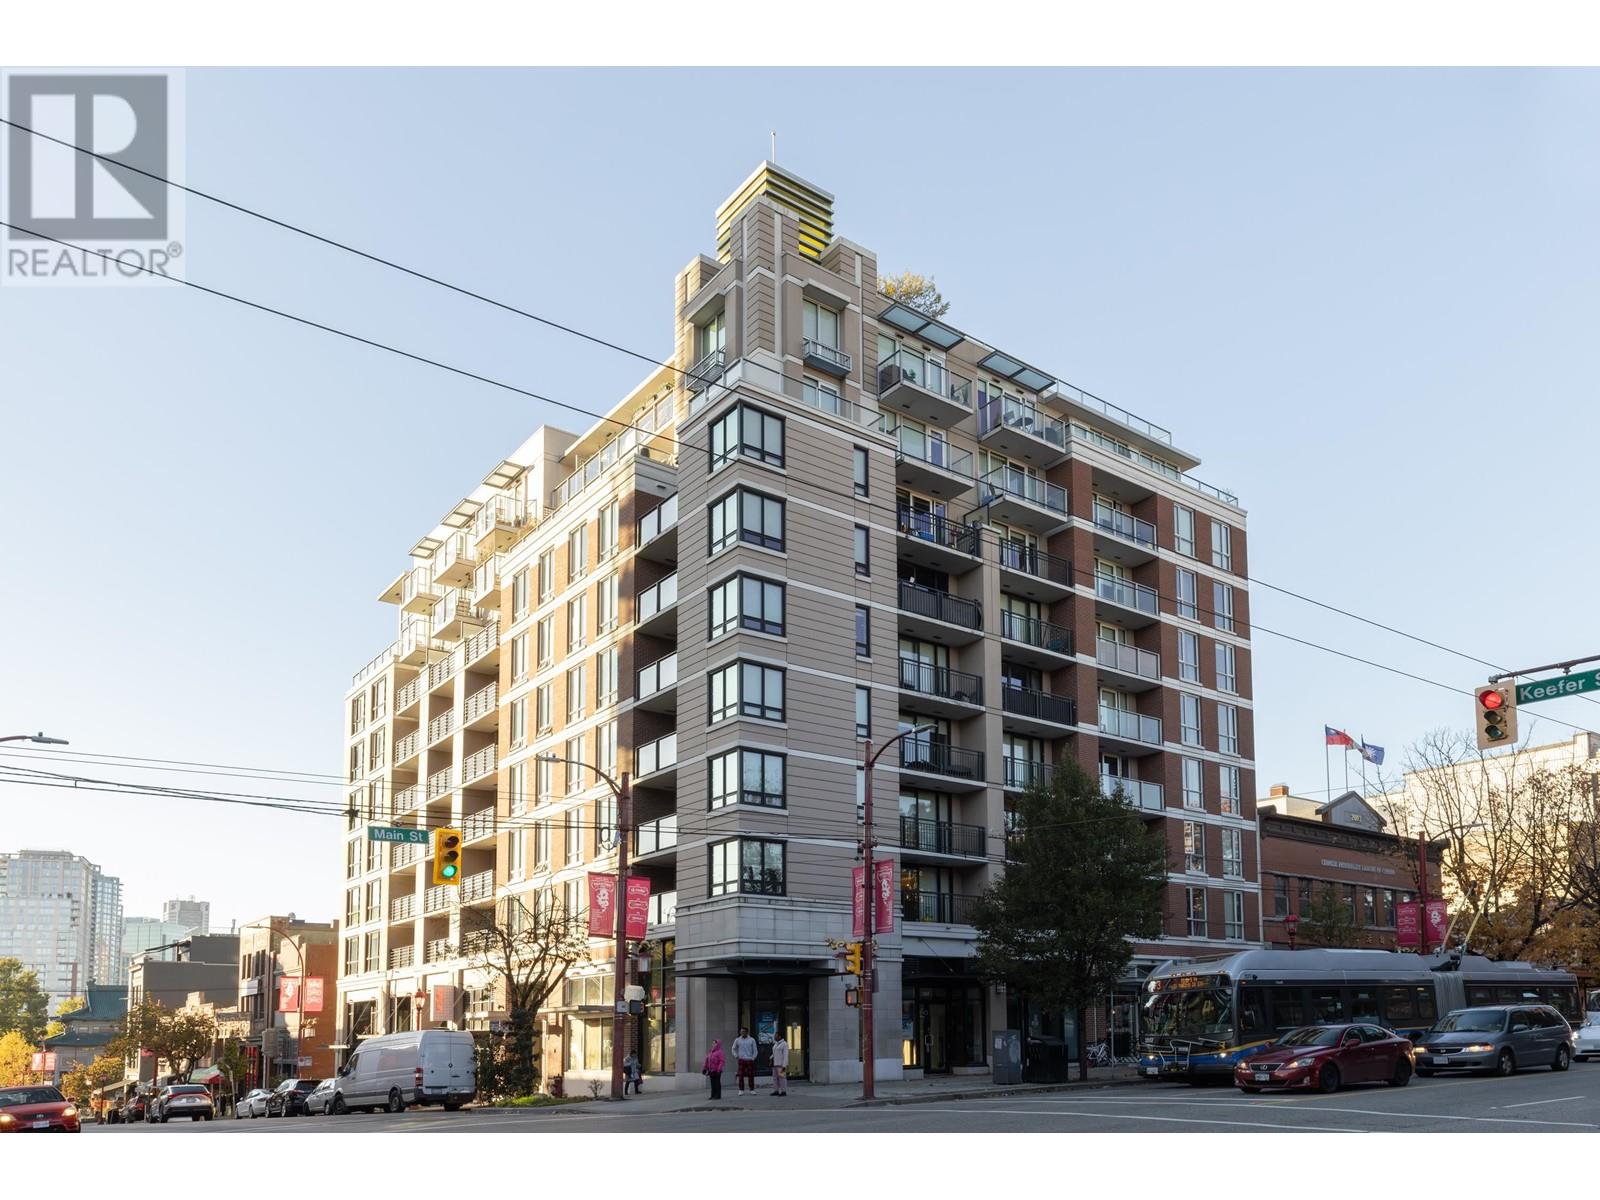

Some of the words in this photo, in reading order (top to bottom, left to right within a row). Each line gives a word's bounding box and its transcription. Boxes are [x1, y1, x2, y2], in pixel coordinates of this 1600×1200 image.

[1519, 679, 1586, 701] Keefer
[374, 829, 404, 841] Main
[409, 831, 424, 842] St
